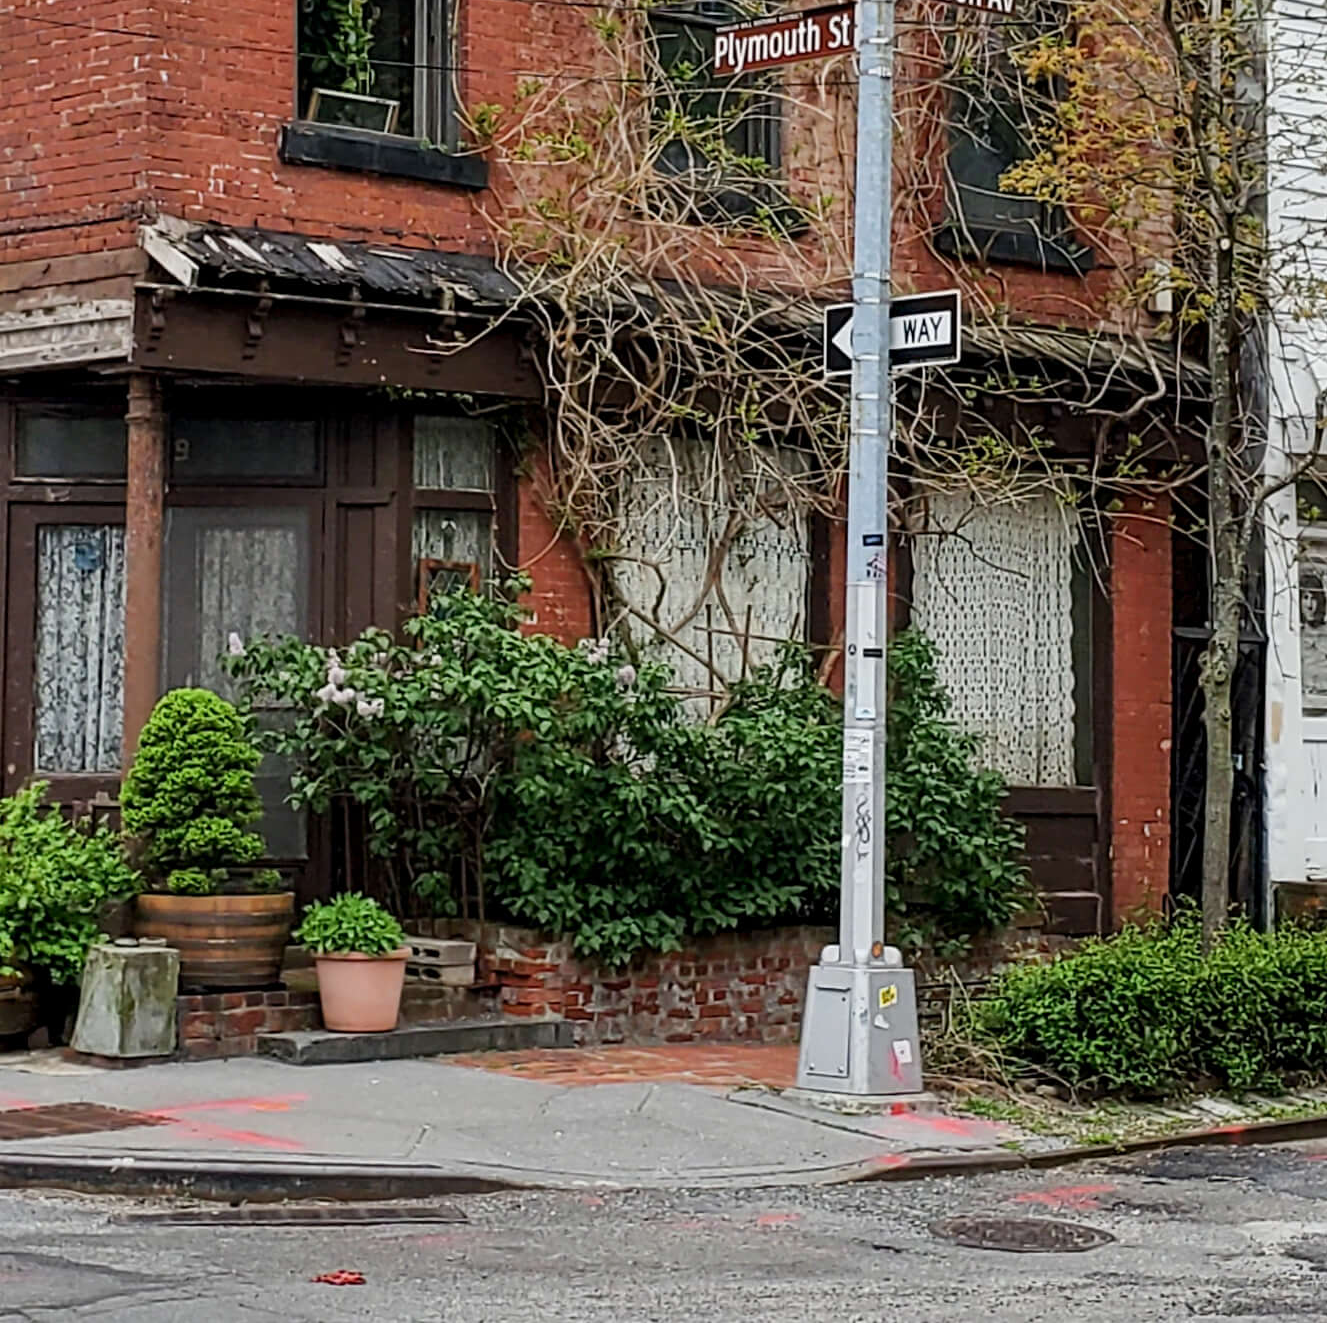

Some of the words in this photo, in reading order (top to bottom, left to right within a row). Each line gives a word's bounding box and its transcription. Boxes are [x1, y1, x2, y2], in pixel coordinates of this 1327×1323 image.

[714, 17, 821, 74] Plymouth
[827, 12, 851, 49] St
[903, 316, 943, 345] WAY
